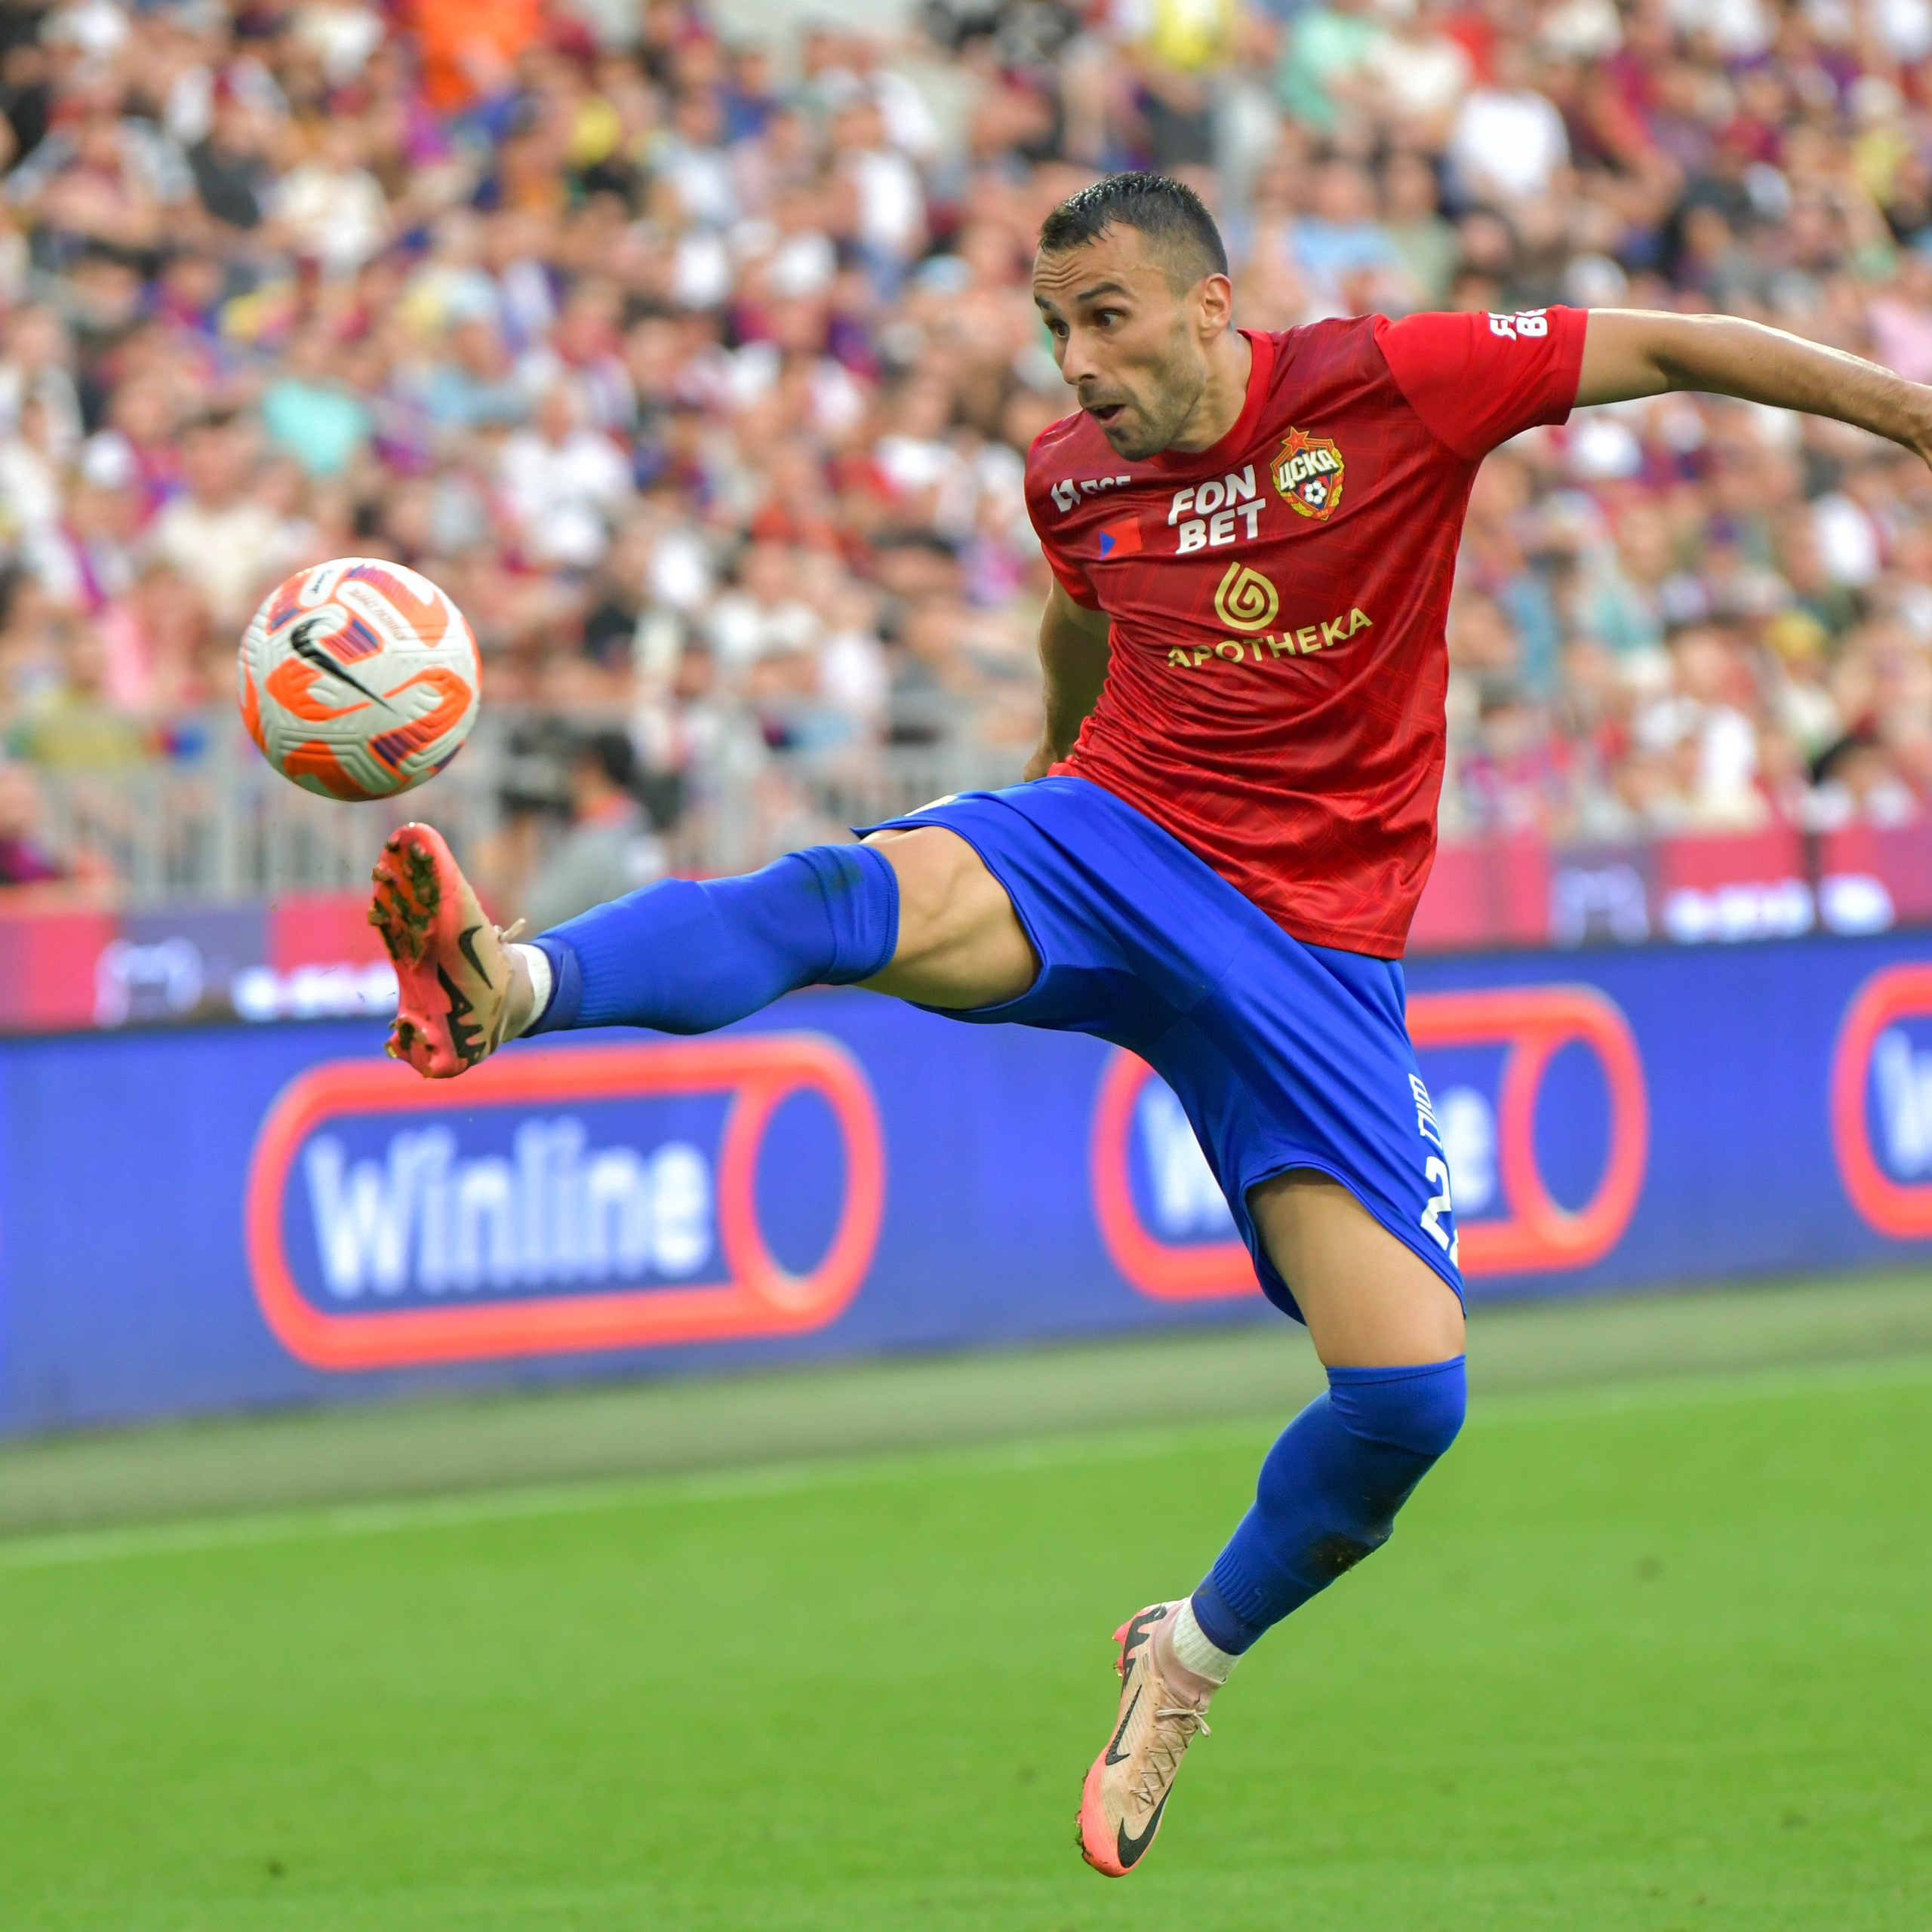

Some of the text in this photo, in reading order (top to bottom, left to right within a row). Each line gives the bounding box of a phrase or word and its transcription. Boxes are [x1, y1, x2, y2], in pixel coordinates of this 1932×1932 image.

[1168, 464, 1257, 525] FON
[1278, 449, 1340, 491] ЦСКА
[1175, 497, 1266, 555] BET
[1167, 607, 1374, 668] APOTHEKA
[307, 1117, 711, 1297] Winline
